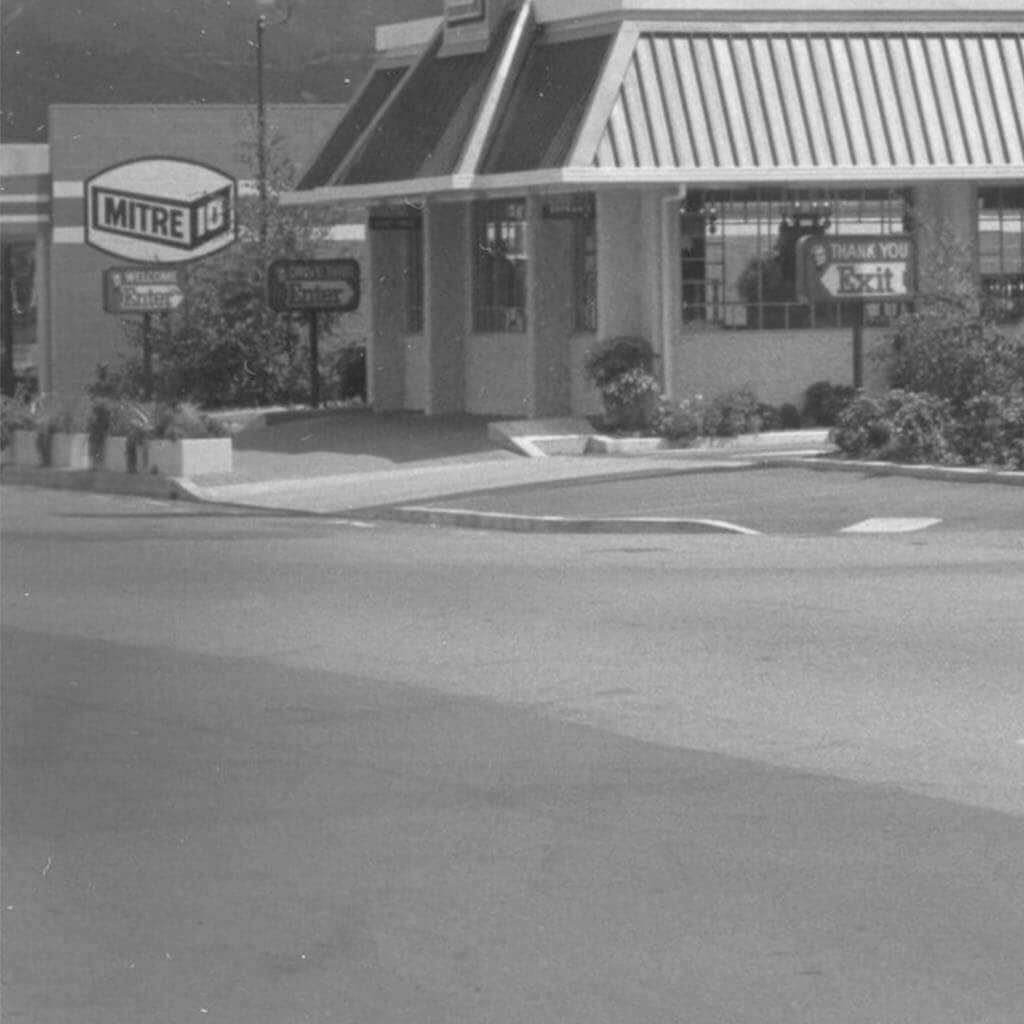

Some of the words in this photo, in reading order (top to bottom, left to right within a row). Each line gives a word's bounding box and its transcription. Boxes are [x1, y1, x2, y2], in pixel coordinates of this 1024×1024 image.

[104, 196, 185, 240] MITRE
[197, 198, 223, 237] 10
[830, 242, 876, 260] THANK
[879, 242, 909, 259] YOU
[837, 265, 894, 293] Exit
